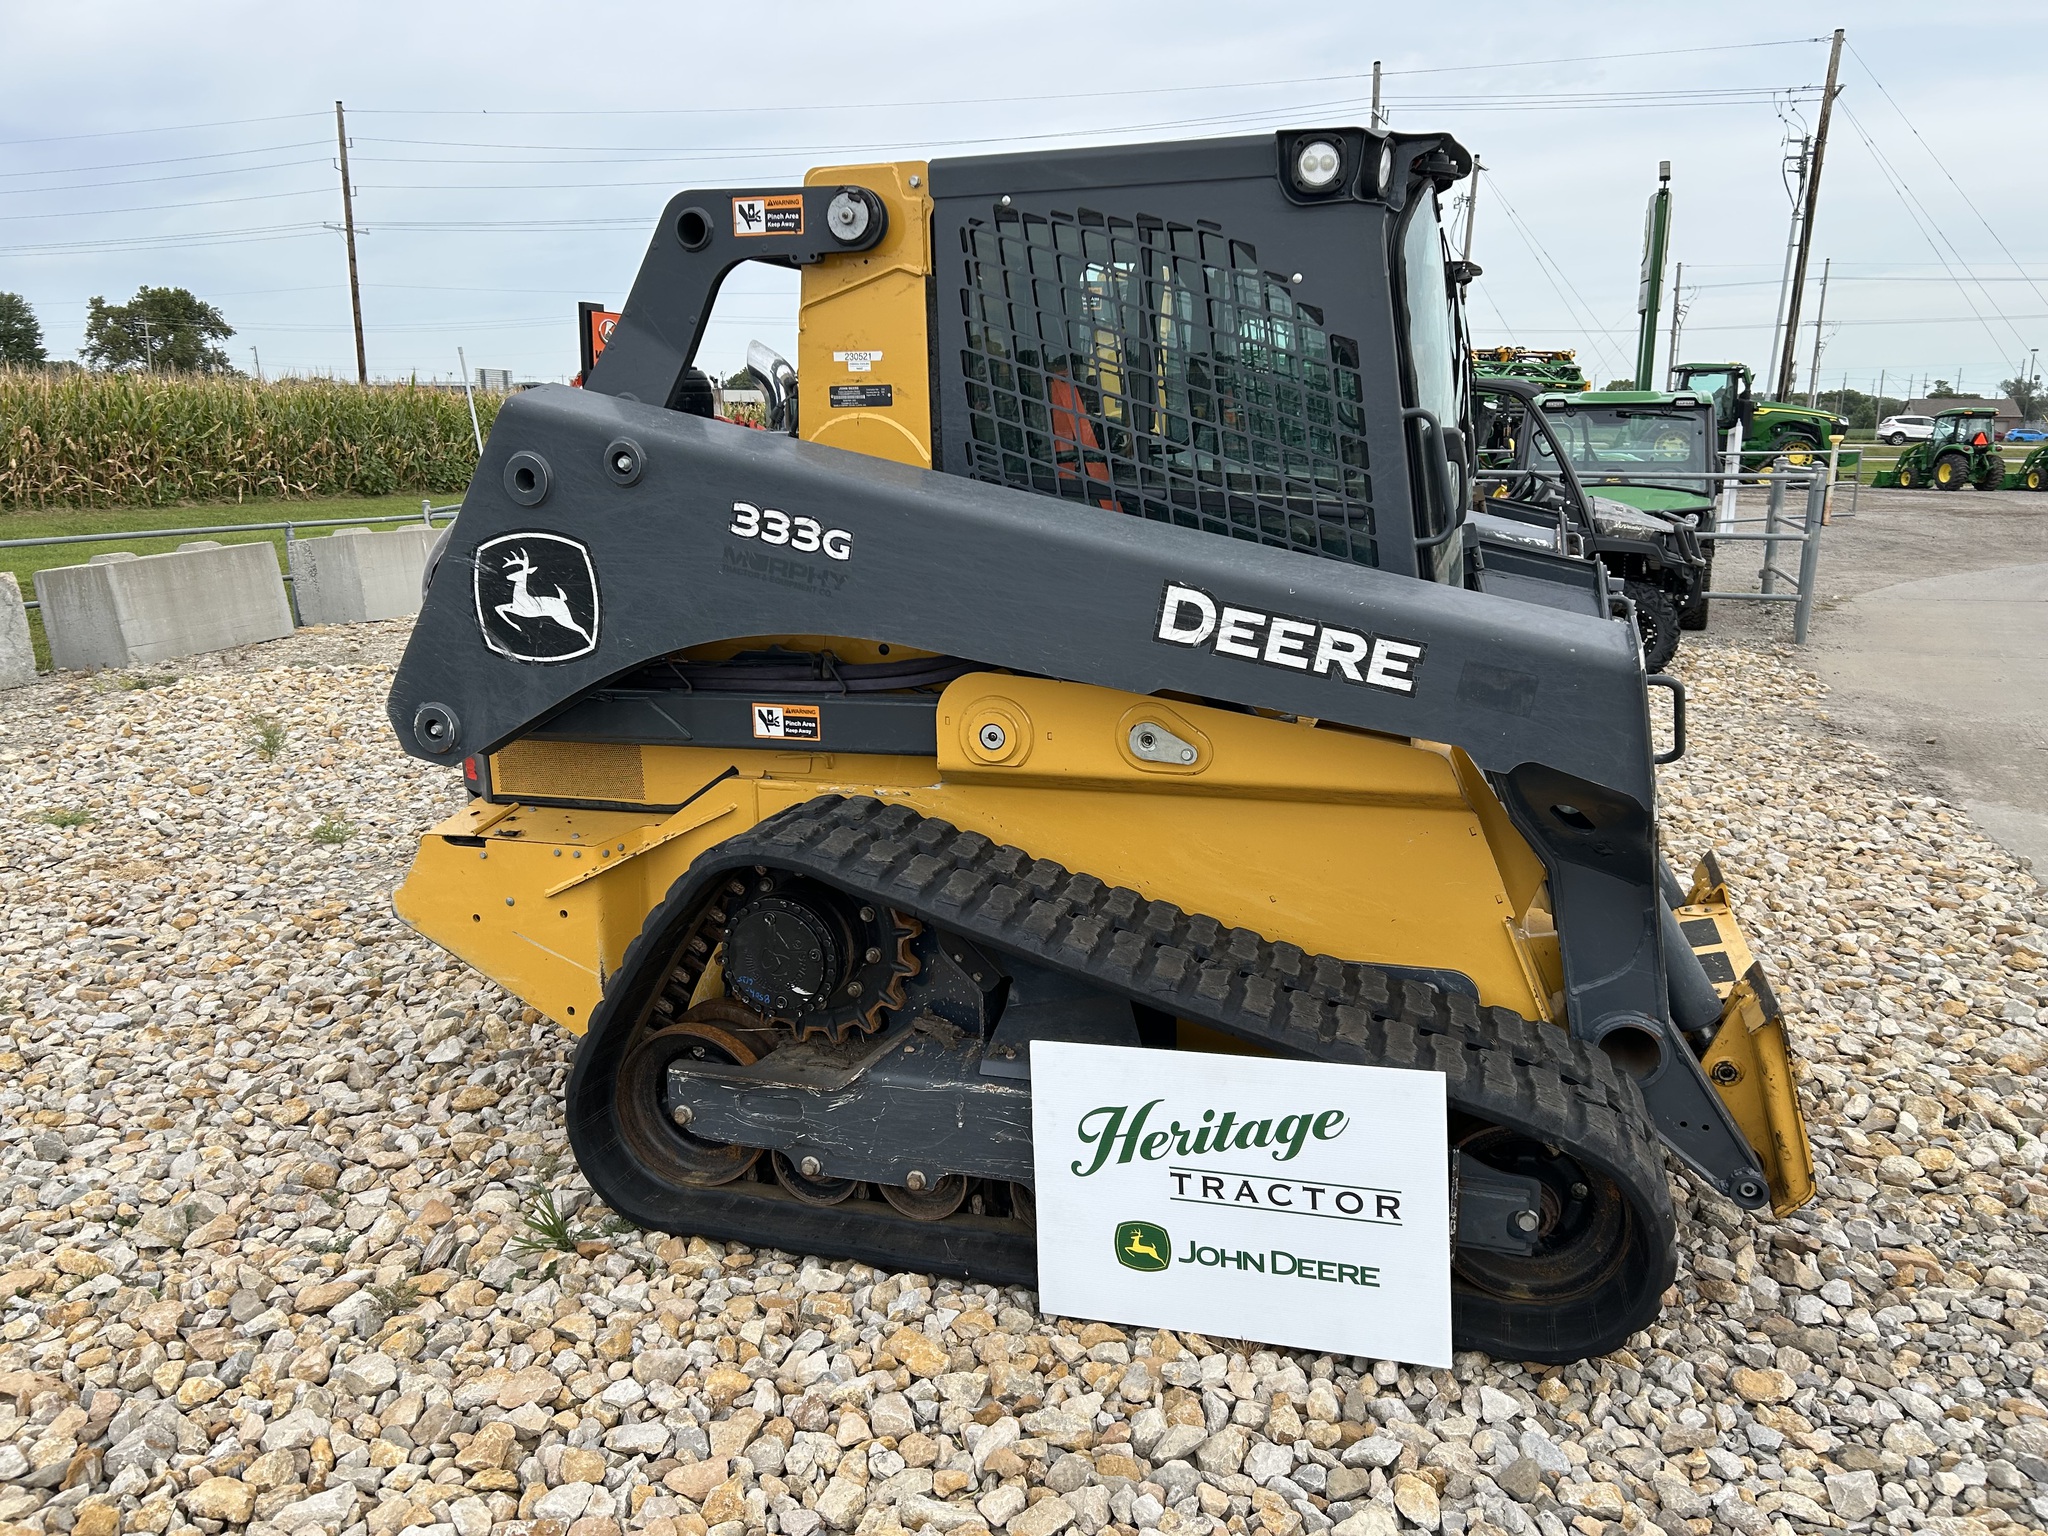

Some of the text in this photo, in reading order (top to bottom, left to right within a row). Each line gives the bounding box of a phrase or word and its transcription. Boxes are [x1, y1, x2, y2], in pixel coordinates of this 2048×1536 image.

[767, 212, 799, 220] Pinch Area
[844, 352, 872, 361] 230521
[730, 502, 853, 561] 333G
[723, 546, 848, 591] MURPHY
[769, 576, 817, 594] EQUIPMENT
[1158, 585, 1421, 692] DEERE
[802, 720, 816, 728] Area
[1070, 1098, 1350, 1177] Heritage
[1169, 1171, 1402, 1220] TRACTOR
[1178, 1240, 1381, 1288] JOHN DEERE
